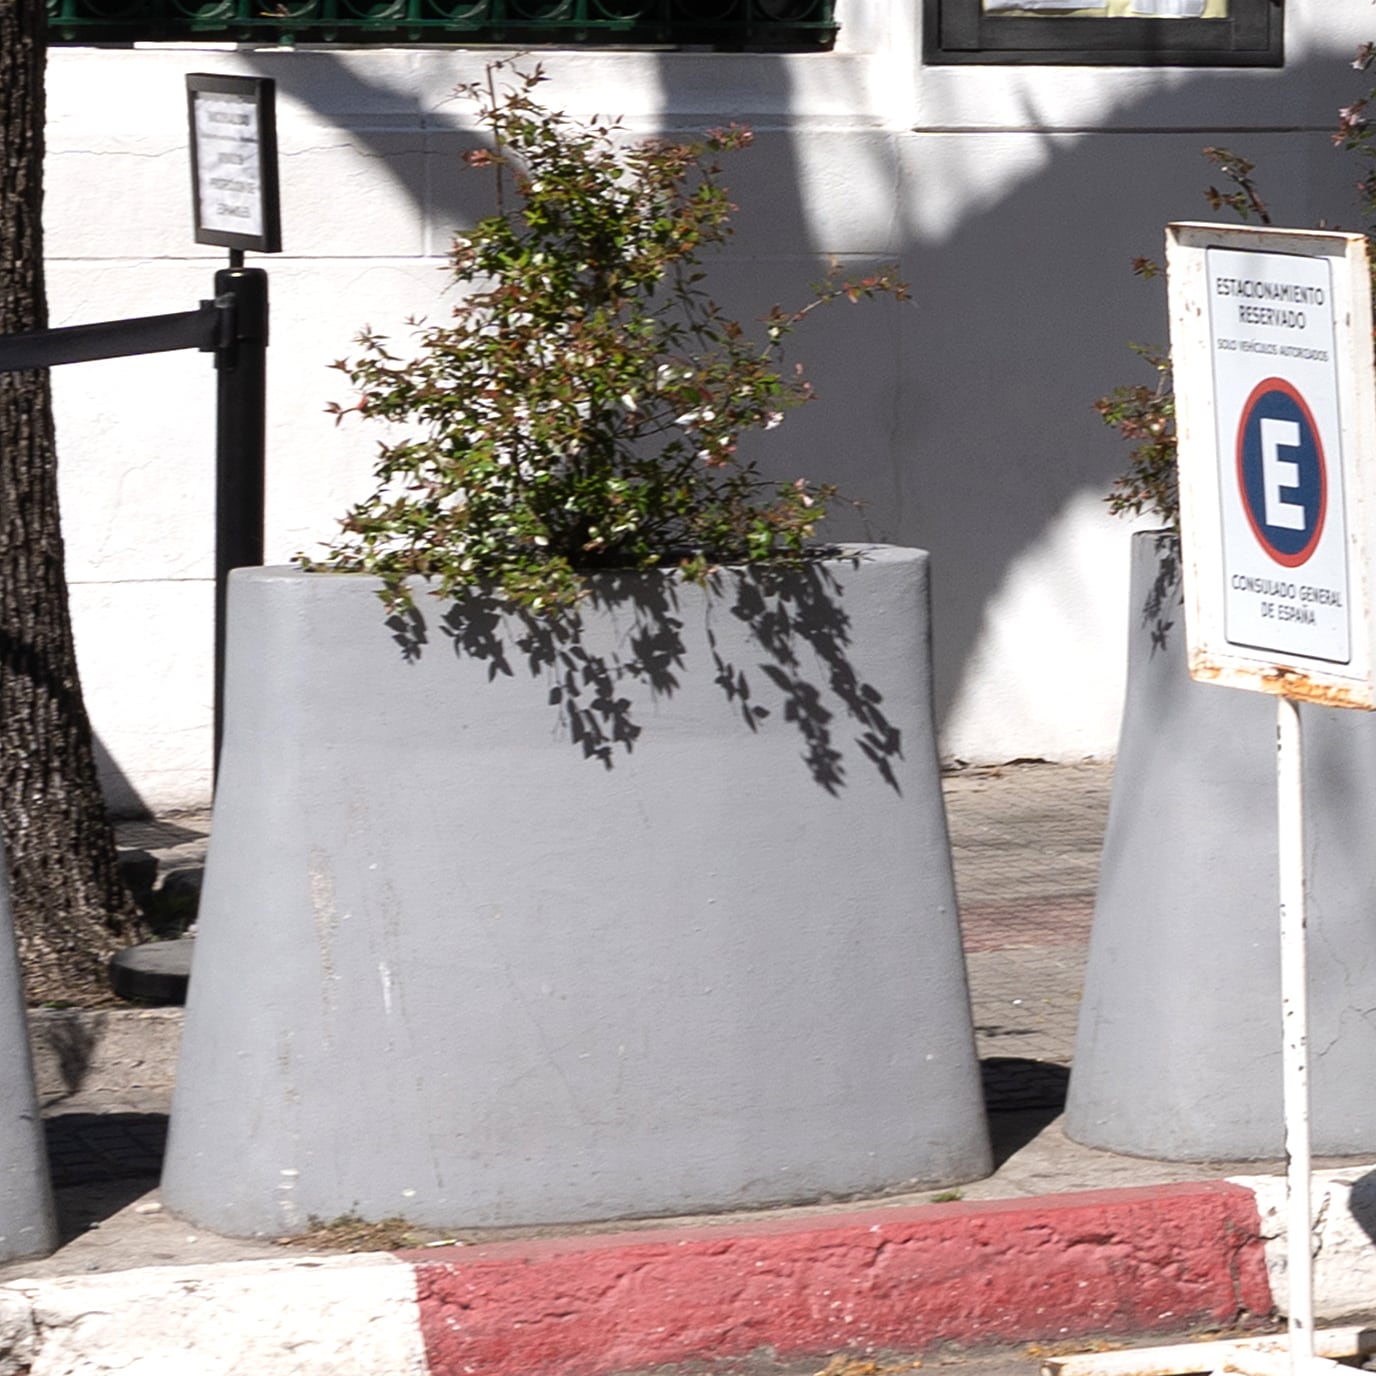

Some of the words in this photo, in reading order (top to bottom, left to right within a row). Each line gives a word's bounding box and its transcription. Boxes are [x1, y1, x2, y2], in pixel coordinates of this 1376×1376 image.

[1217, 277, 1324, 305] ESTACIONAMIENTO
[1239, 305, 1306, 329] RESERVADO
[1217, 338, 1236, 350] SOLO
[1260, 418, 1306, 531] E
[1232, 574, 1296, 599] CONSULADO
[1299, 585, 1342, 607] GENERAL
[1261, 601, 1275, 618] DE
[1278, 603, 1316, 625] ESPAÑA
